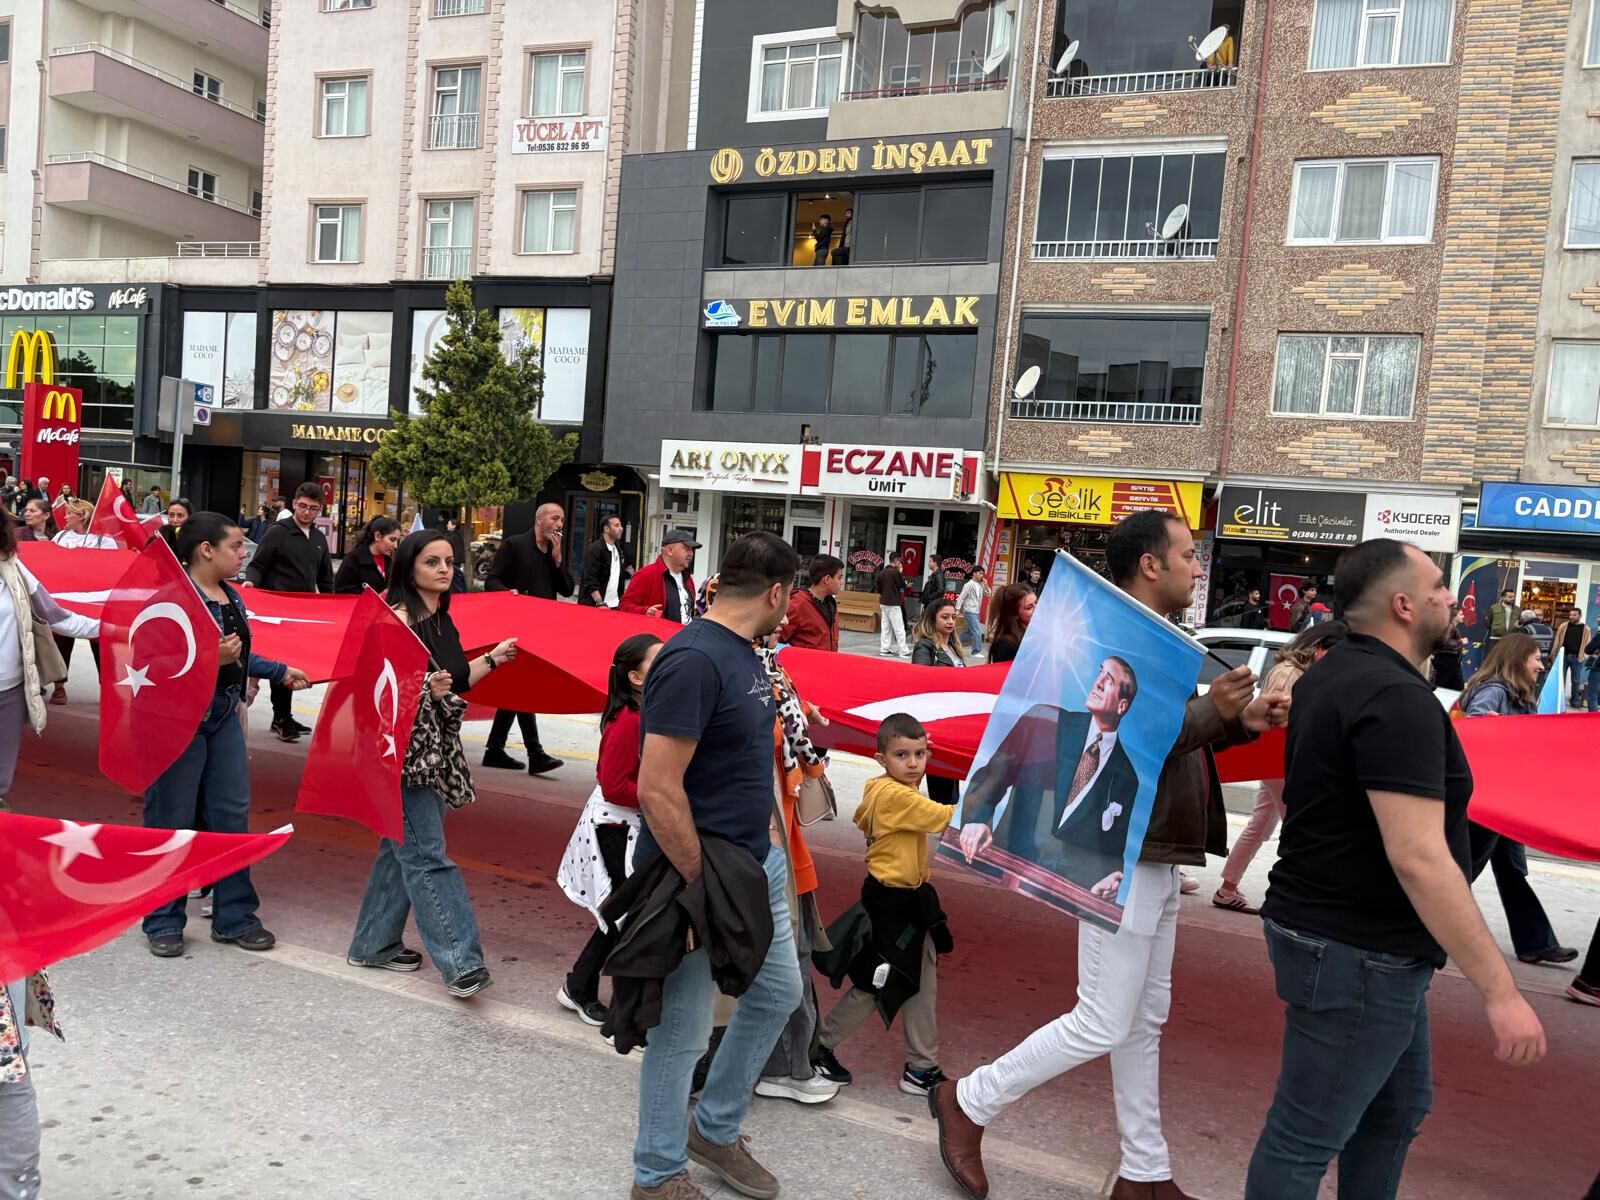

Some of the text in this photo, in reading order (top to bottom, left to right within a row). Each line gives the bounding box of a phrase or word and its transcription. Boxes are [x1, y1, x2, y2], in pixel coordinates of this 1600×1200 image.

[517, 119, 603, 142] YÜCEL APT
[556, 142, 569, 151] 832
[570, 142, 579, 150] 96
[580, 141, 590, 150] 95
[755, 139, 992, 177] ÖZDEN İNŞAAT
[748, 296, 979, 326] EVİM EMLAK
[189, 344, 220, 352] MADAME
[549, 347, 588, 356] MADAME
[193, 351, 214, 359] COCO
[554, 355, 580, 364] COCO
[291, 424, 361, 442] MADAME
[670, 449, 790, 475] ARI ONYX
[827, 448, 954, 478] ECZANE
[868, 478, 906, 493] ÜMİT
[1027, 488, 1102, 517] gedik
[1129, 495, 1159, 503] SERVİS
[1233, 490, 1282, 527] elit
[1048, 511, 1100, 521] BİSİKLET
[1292, 530, 1318, 540] 0(386)
[1319, 532, 1334, 540] 213
[1383, 527, 1441, 537] Authorized Dealer
[1505, 560, 1532, 569] TEKL
